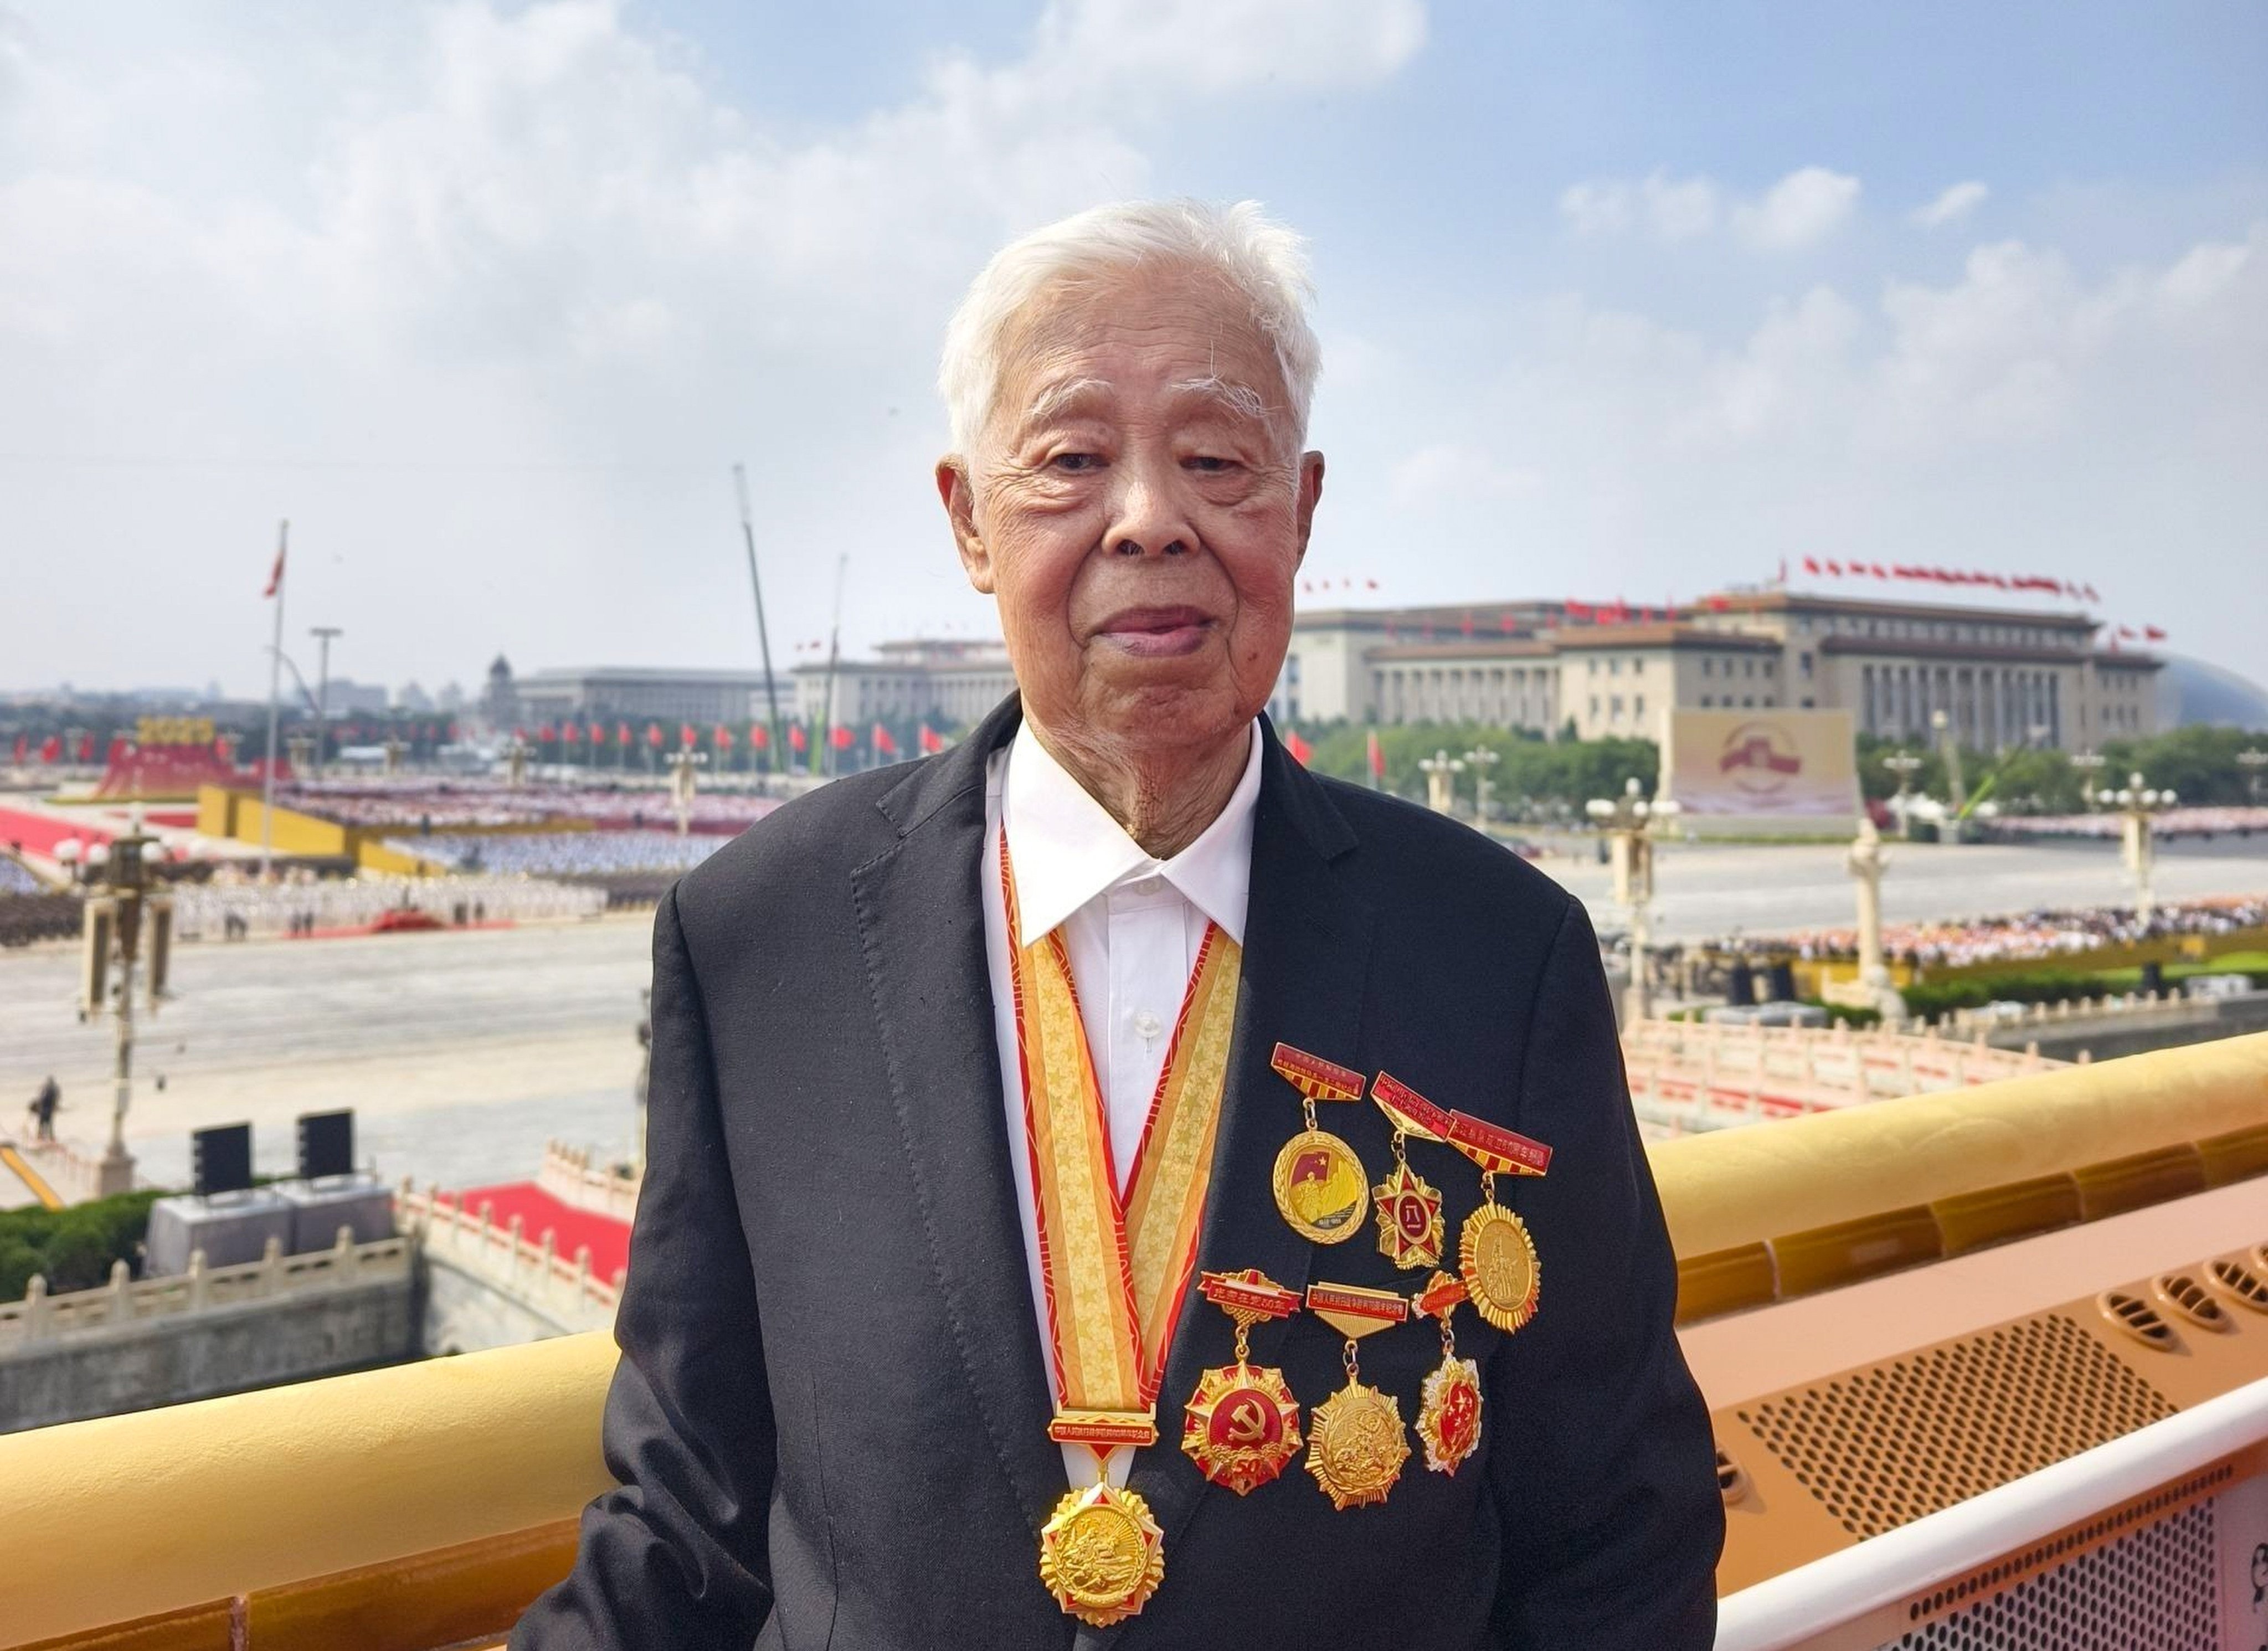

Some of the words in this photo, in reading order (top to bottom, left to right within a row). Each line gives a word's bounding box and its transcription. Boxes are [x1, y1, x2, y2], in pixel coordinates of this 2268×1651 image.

[1213, 1288, 1285, 1310] 光荣在党50年
